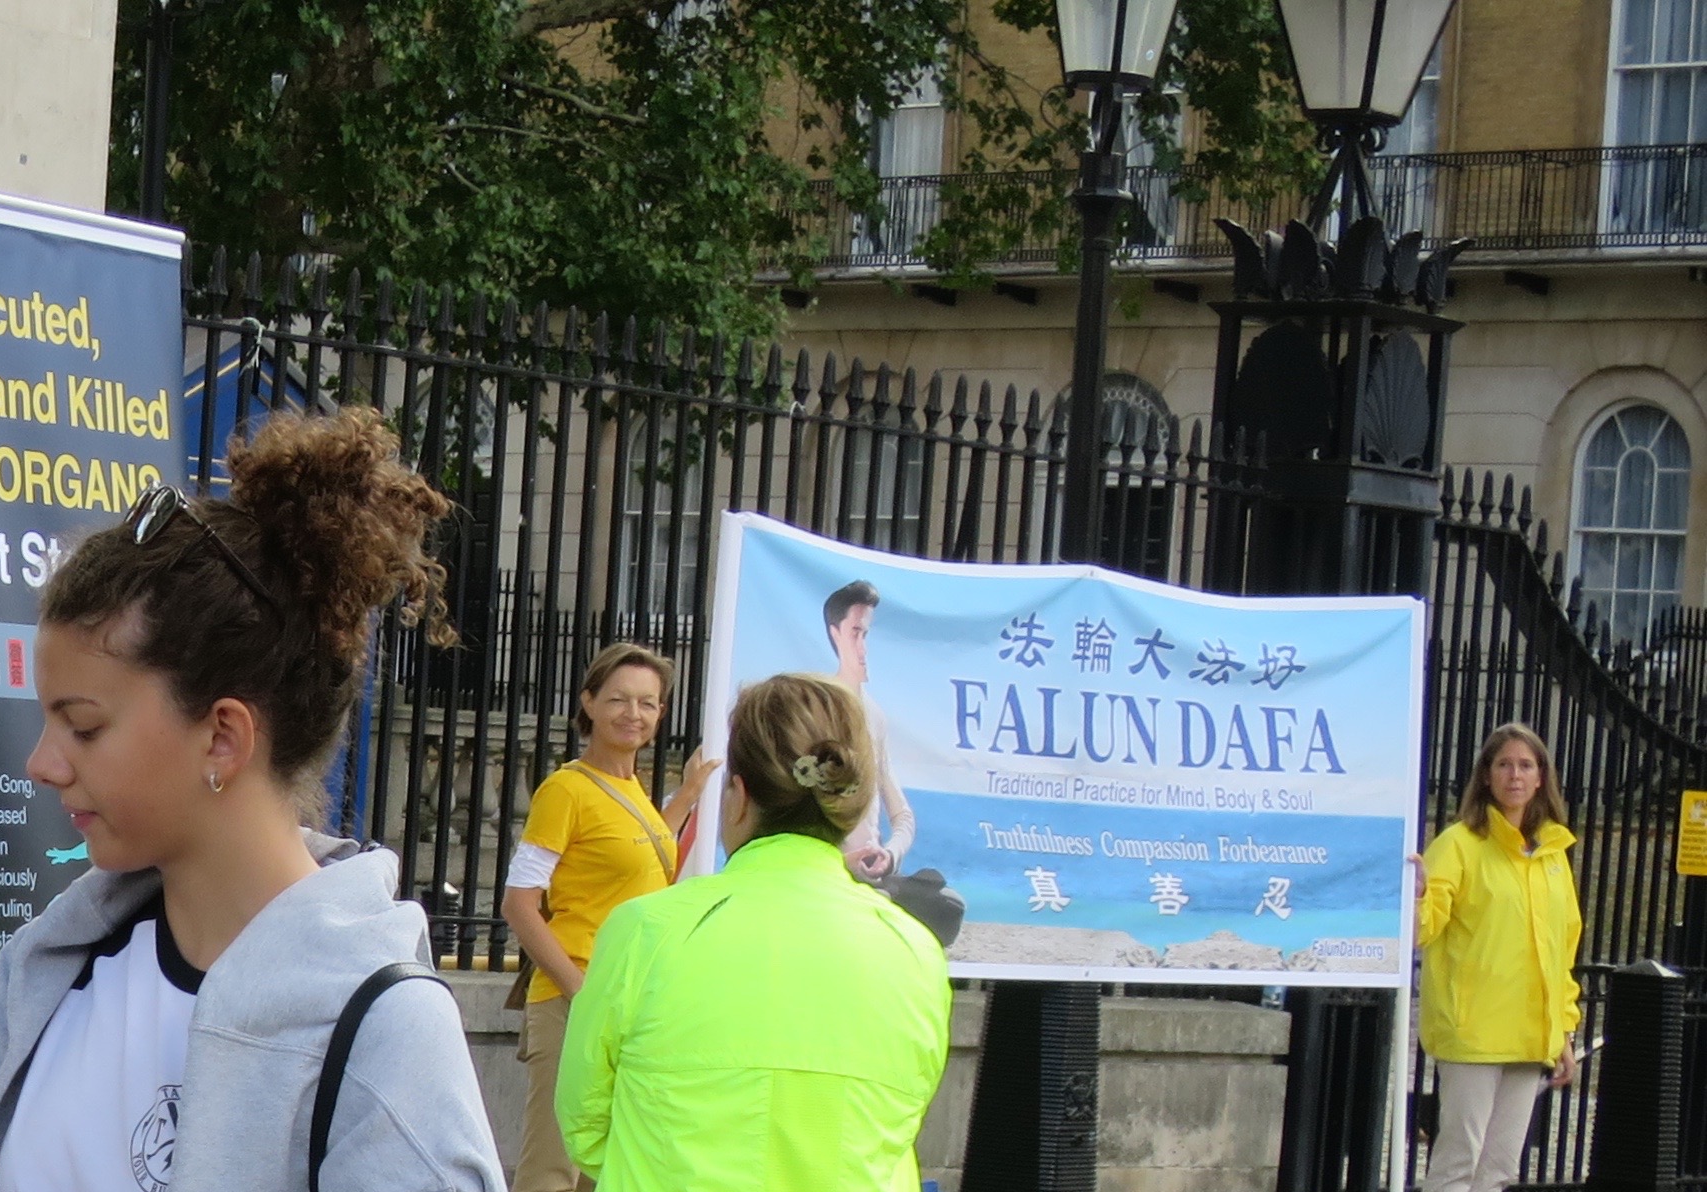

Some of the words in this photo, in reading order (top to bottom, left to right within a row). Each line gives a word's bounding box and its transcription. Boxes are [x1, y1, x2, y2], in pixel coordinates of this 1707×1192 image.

[68, 376, 170, 440] Killed
[1000, 611, 1305, 690] 法輪大法好
[950, 679, 1160, 766] FALUN
[1179, 700, 1346, 774] DAFA
[0, 774, 36, 798] Gong,
[987, 770, 1067, 799] Traditional
[1073, 778, 1136, 804] Practice
[1142, 783, 1161, 805] for
[1166, 785, 1211, 810] Mind,
[1215, 787, 1255, 813] Body
[1262, 790, 1272, 809] &
[1278, 790, 1313, 811] Soul
[979, 821, 1093, 856] Truthfulness
[1101, 831, 1209, 865] Compassion
[1218, 836, 1328, 864] Forbearance
[1024, 866, 1071, 912] 真
[1149, 872, 1189, 915] 善
[1255, 876, 1292, 920] 忍
[1312, 940, 1384, 961] FalunDafa.org
